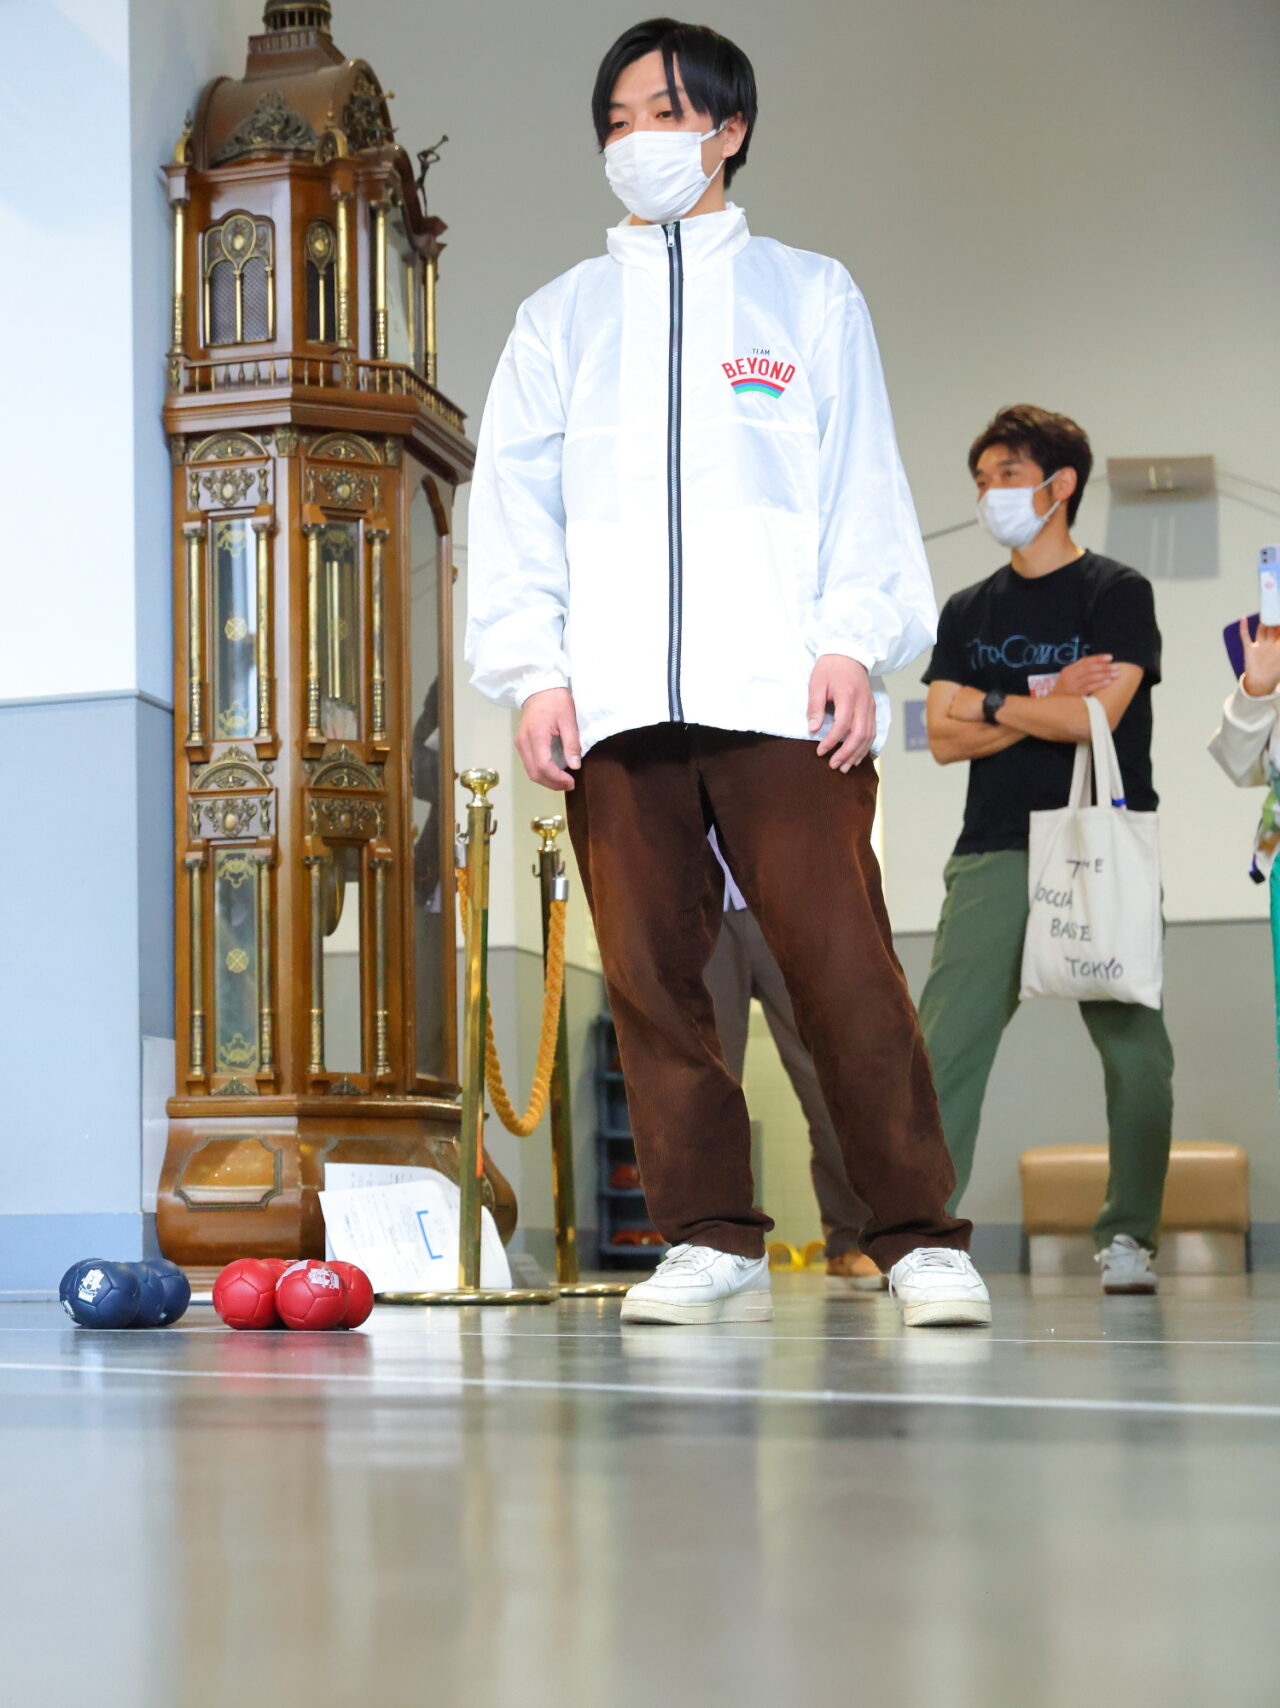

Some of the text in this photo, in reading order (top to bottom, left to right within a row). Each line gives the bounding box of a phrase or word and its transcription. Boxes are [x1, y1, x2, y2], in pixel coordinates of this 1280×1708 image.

[752, 348, 770, 356] TEAM
[721, 357, 796, 384] BEYOND
[1050, 918, 1092, 941] BASE
[1064, 957, 1124, 981] TOKYO
